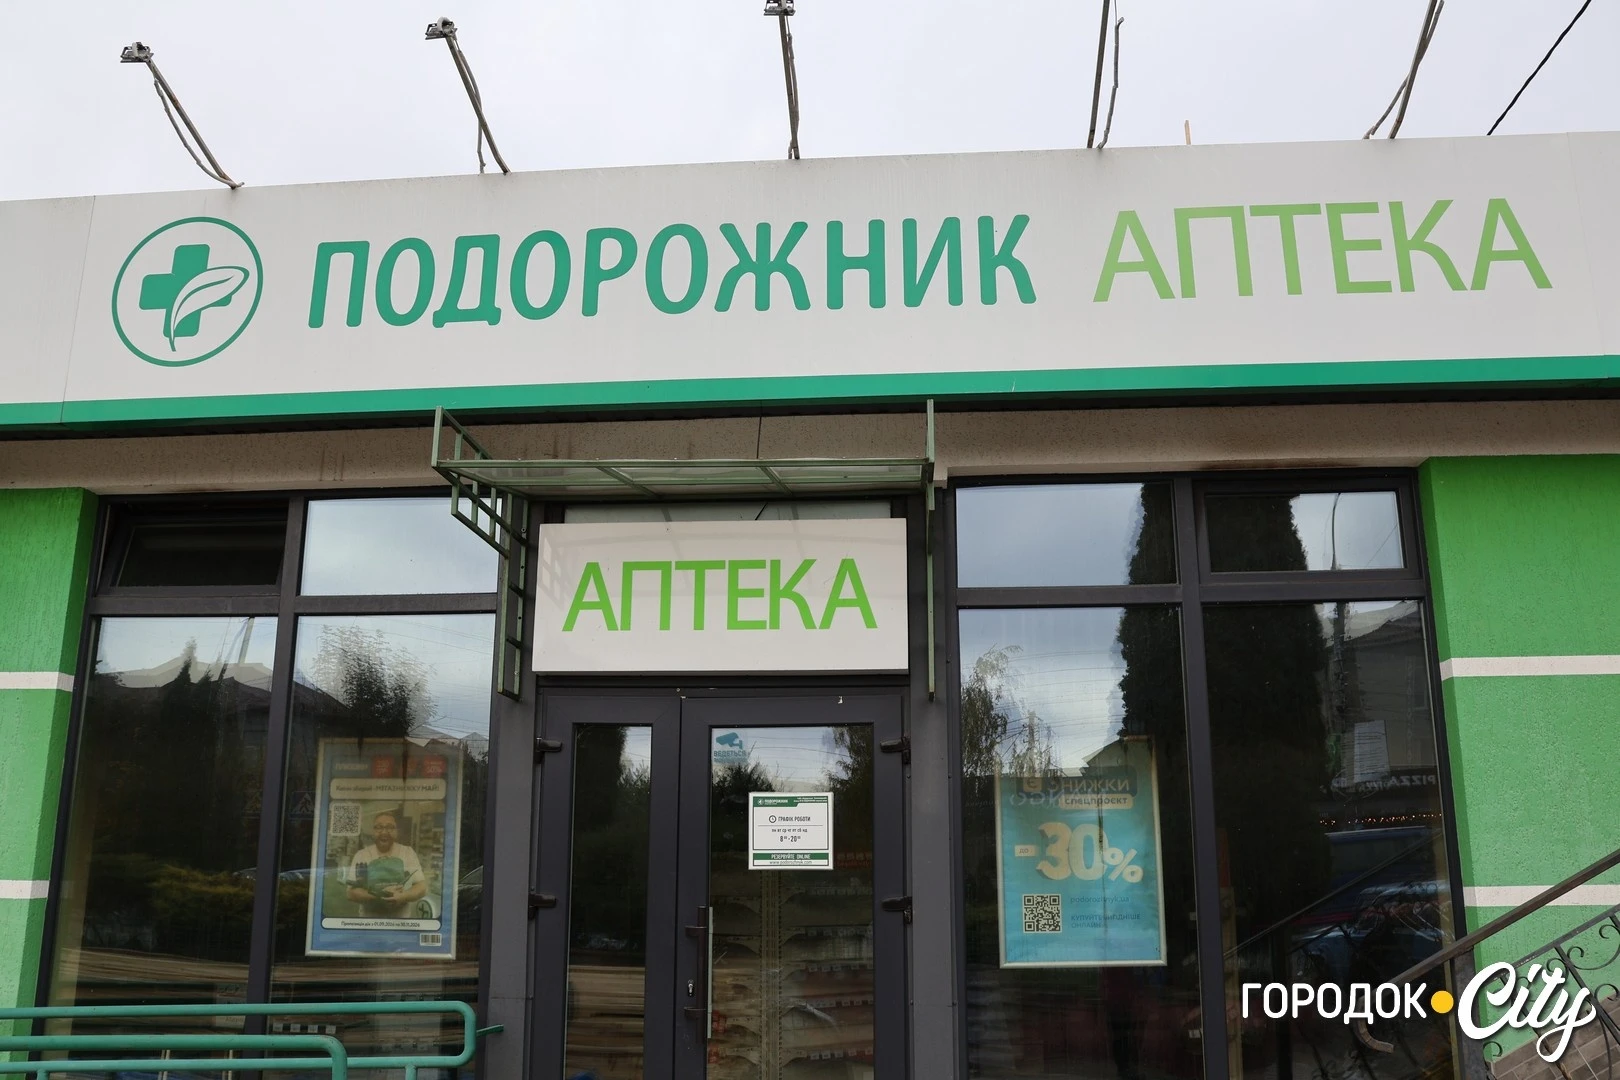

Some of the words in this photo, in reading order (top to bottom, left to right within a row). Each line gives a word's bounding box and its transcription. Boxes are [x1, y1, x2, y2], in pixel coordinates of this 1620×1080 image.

[308, 214, 1037, 329] ПОДОРОЖНИК
[1095, 198, 1552, 302] АПТЕКА
[562, 558, 878, 632] АПТЕКА
[1047, 778, 1130, 793] ЗНИЖКИ
